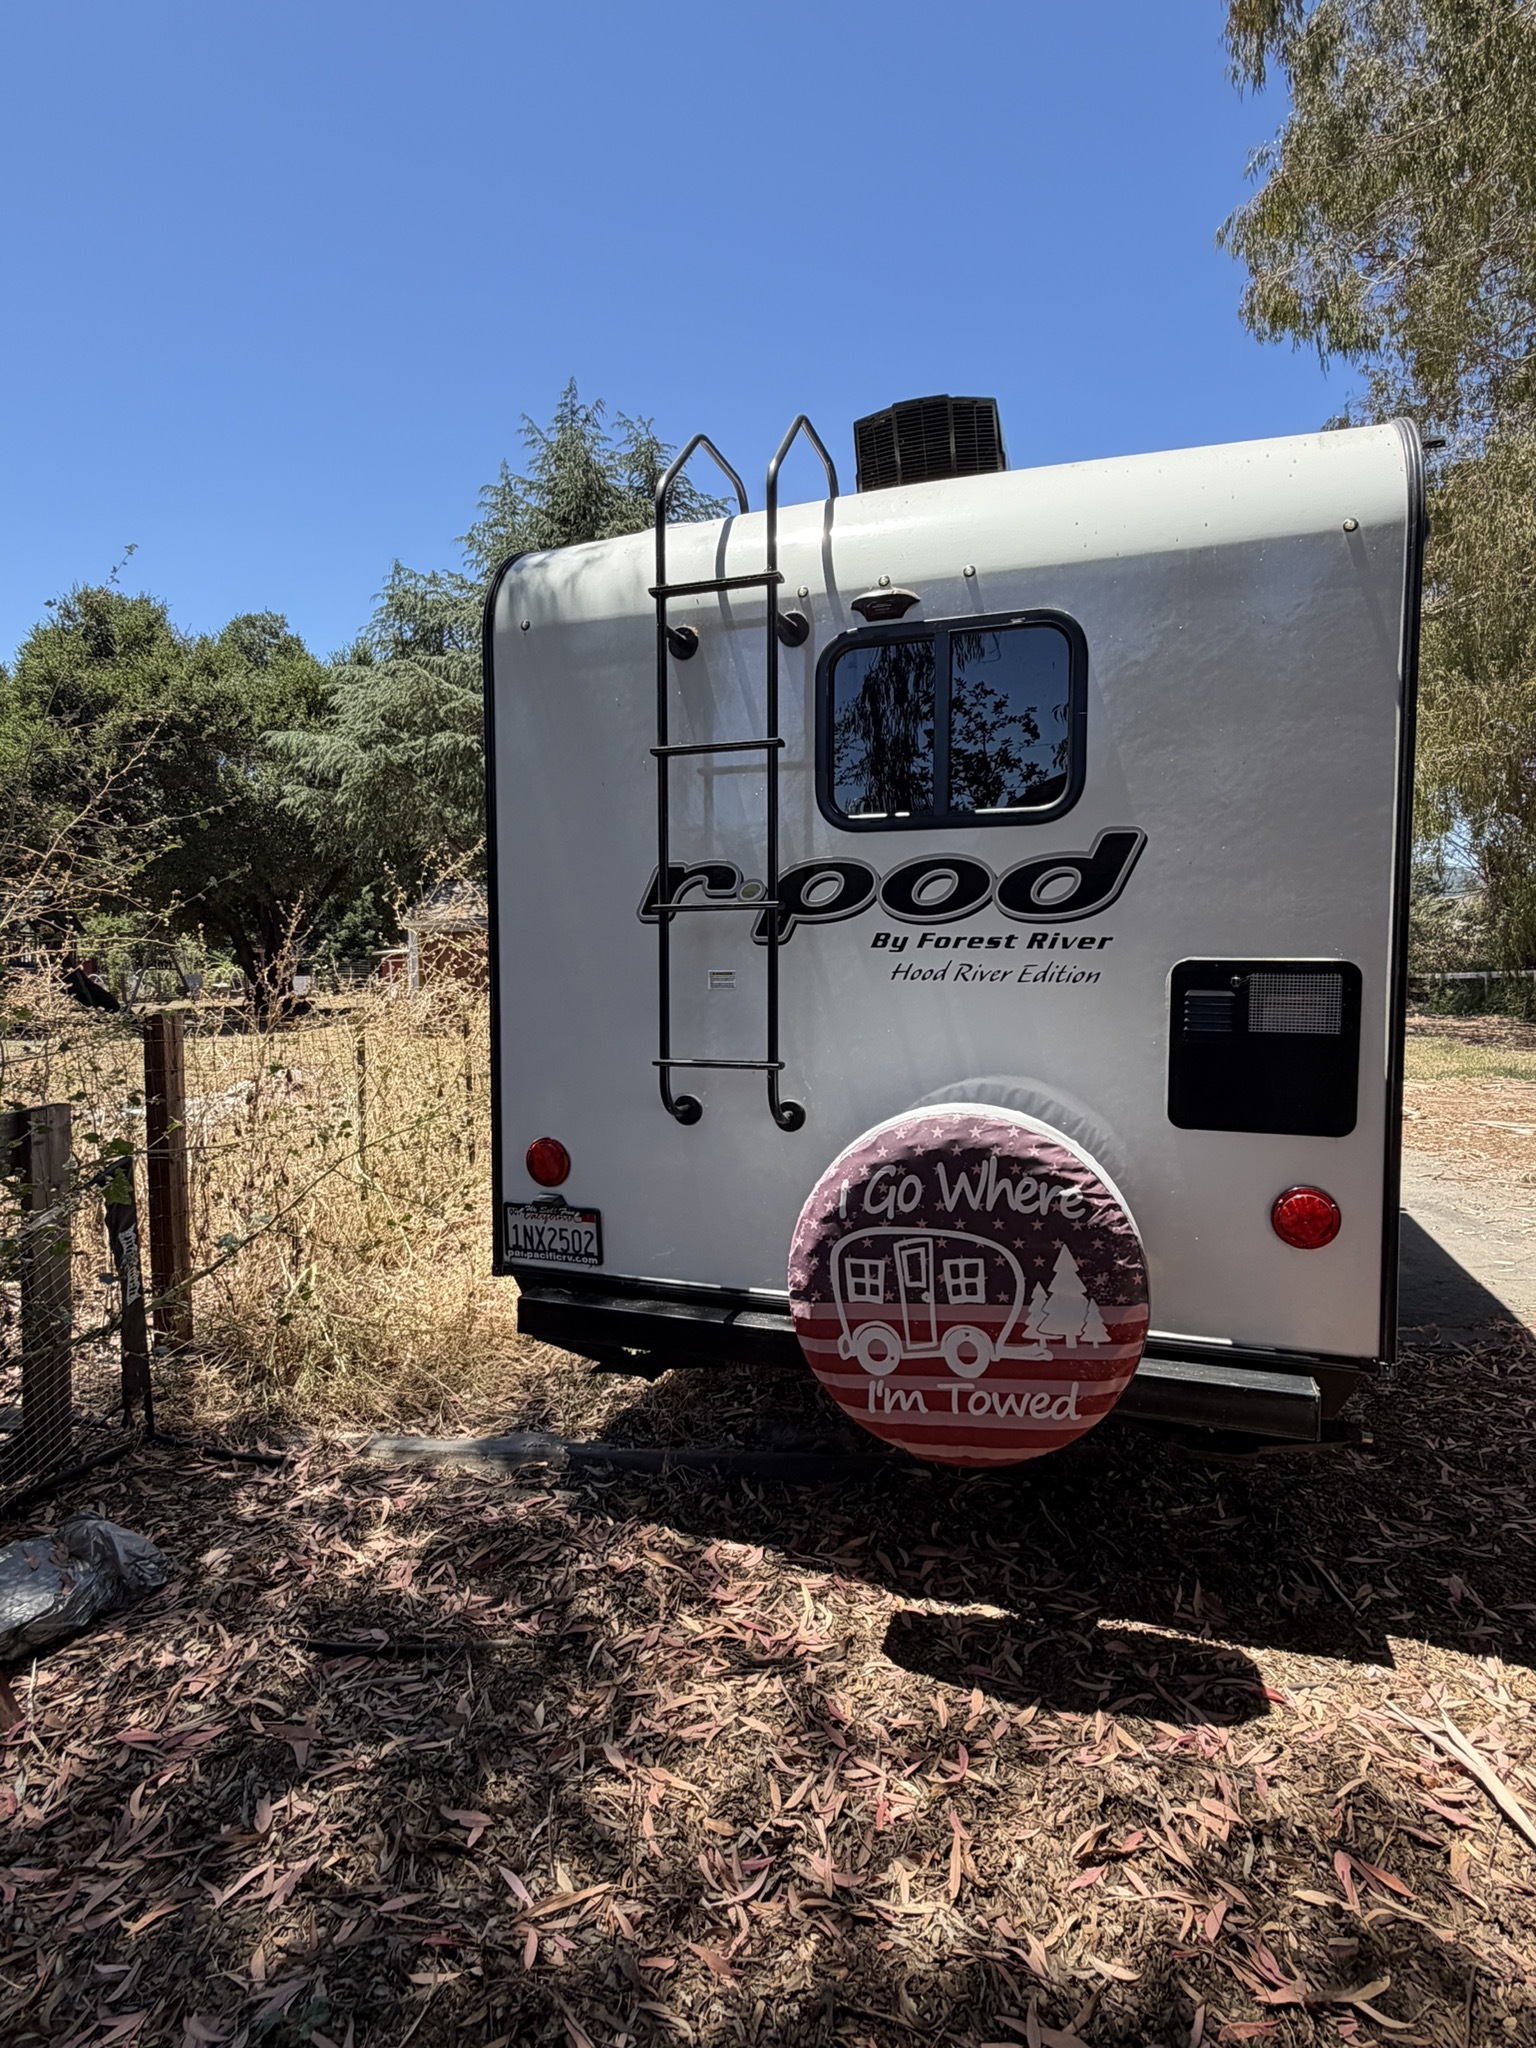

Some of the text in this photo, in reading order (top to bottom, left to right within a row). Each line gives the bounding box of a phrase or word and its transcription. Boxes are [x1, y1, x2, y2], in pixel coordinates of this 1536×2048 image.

[871, 932, 1114, 953] By Forest River
[890, 960, 1101, 984] Hood River Edition
[839, 1155, 1086, 1219] I Go Where
[539, 1206, 558, 1214] Sell
[512, 1224, 594, 1255] 1NX2502
[867, 1379, 1081, 1421] I'm Towed
